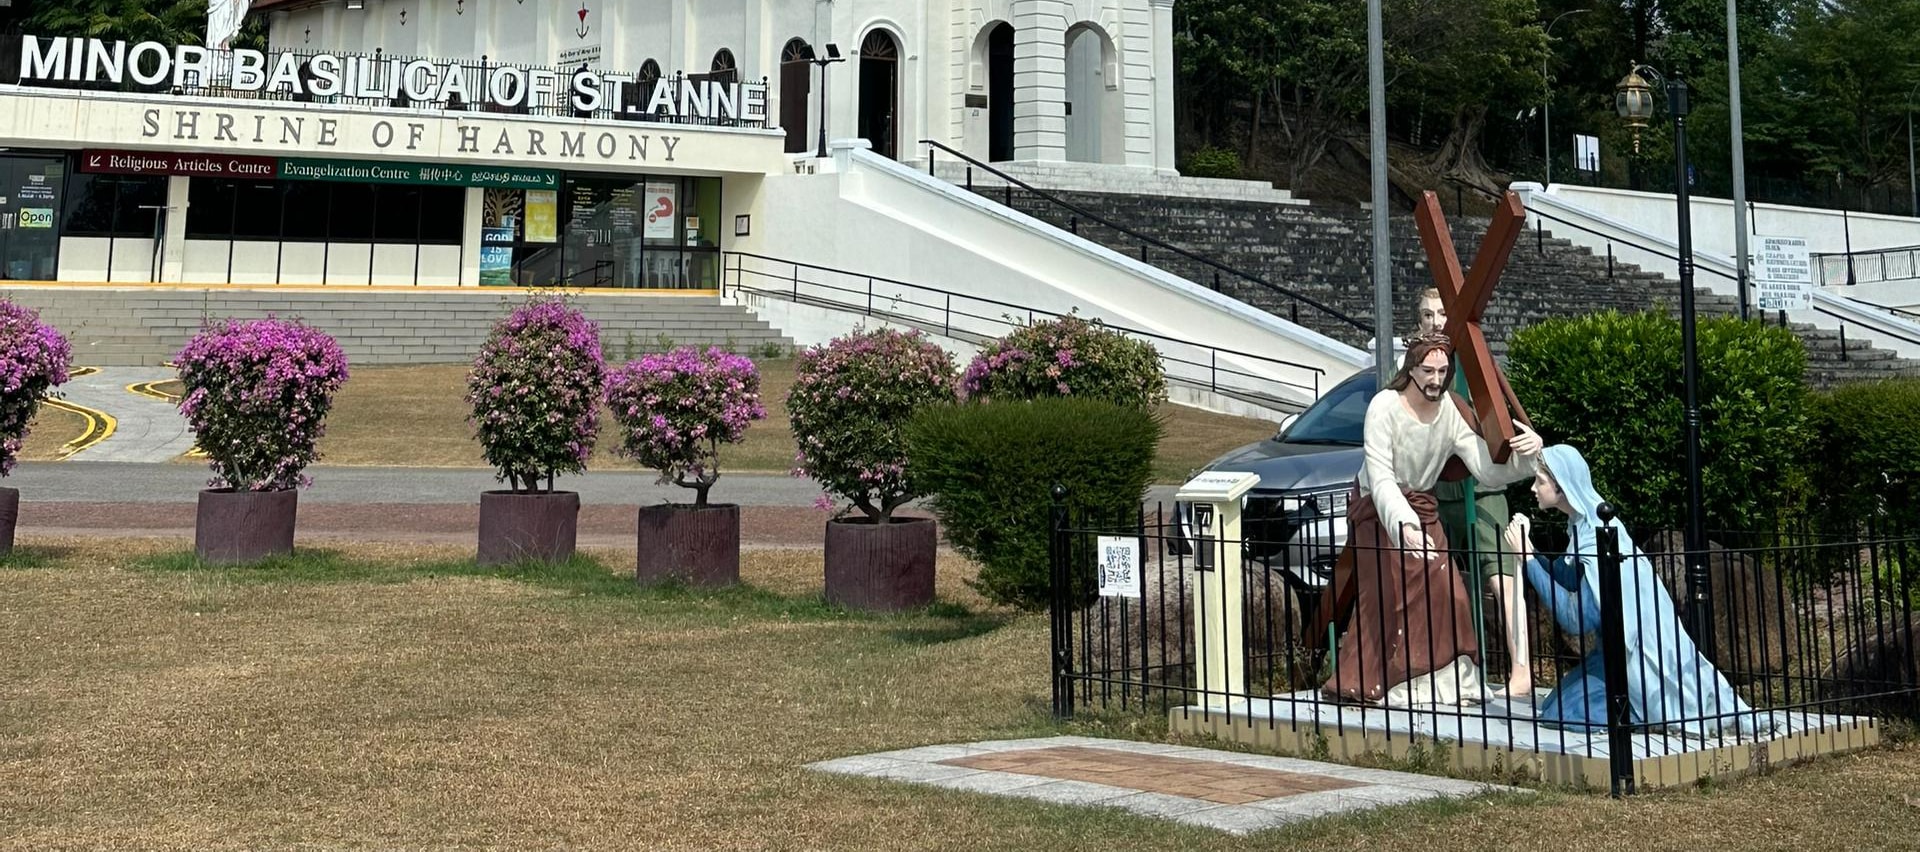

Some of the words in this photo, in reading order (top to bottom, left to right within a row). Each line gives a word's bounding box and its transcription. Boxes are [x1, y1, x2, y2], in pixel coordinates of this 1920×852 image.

[20, 34, 210, 88] MINOR
[230, 49, 471, 104] BASILICA
[489, 66, 555, 109] OF
[142, 109, 338, 146] SHRINE
[371, 120, 425, 149] OF
[457, 125, 682, 161] HARMONY
[109, 154, 168, 172] Religious
[174, 158, 223, 172] Articles
[228, 160, 271, 174] Centre
[284, 161, 369, 179] Evangelization
[370, 166, 411, 180] Centre
[21, 211, 52, 223] Open
[481, 253, 509, 264] LOVE
